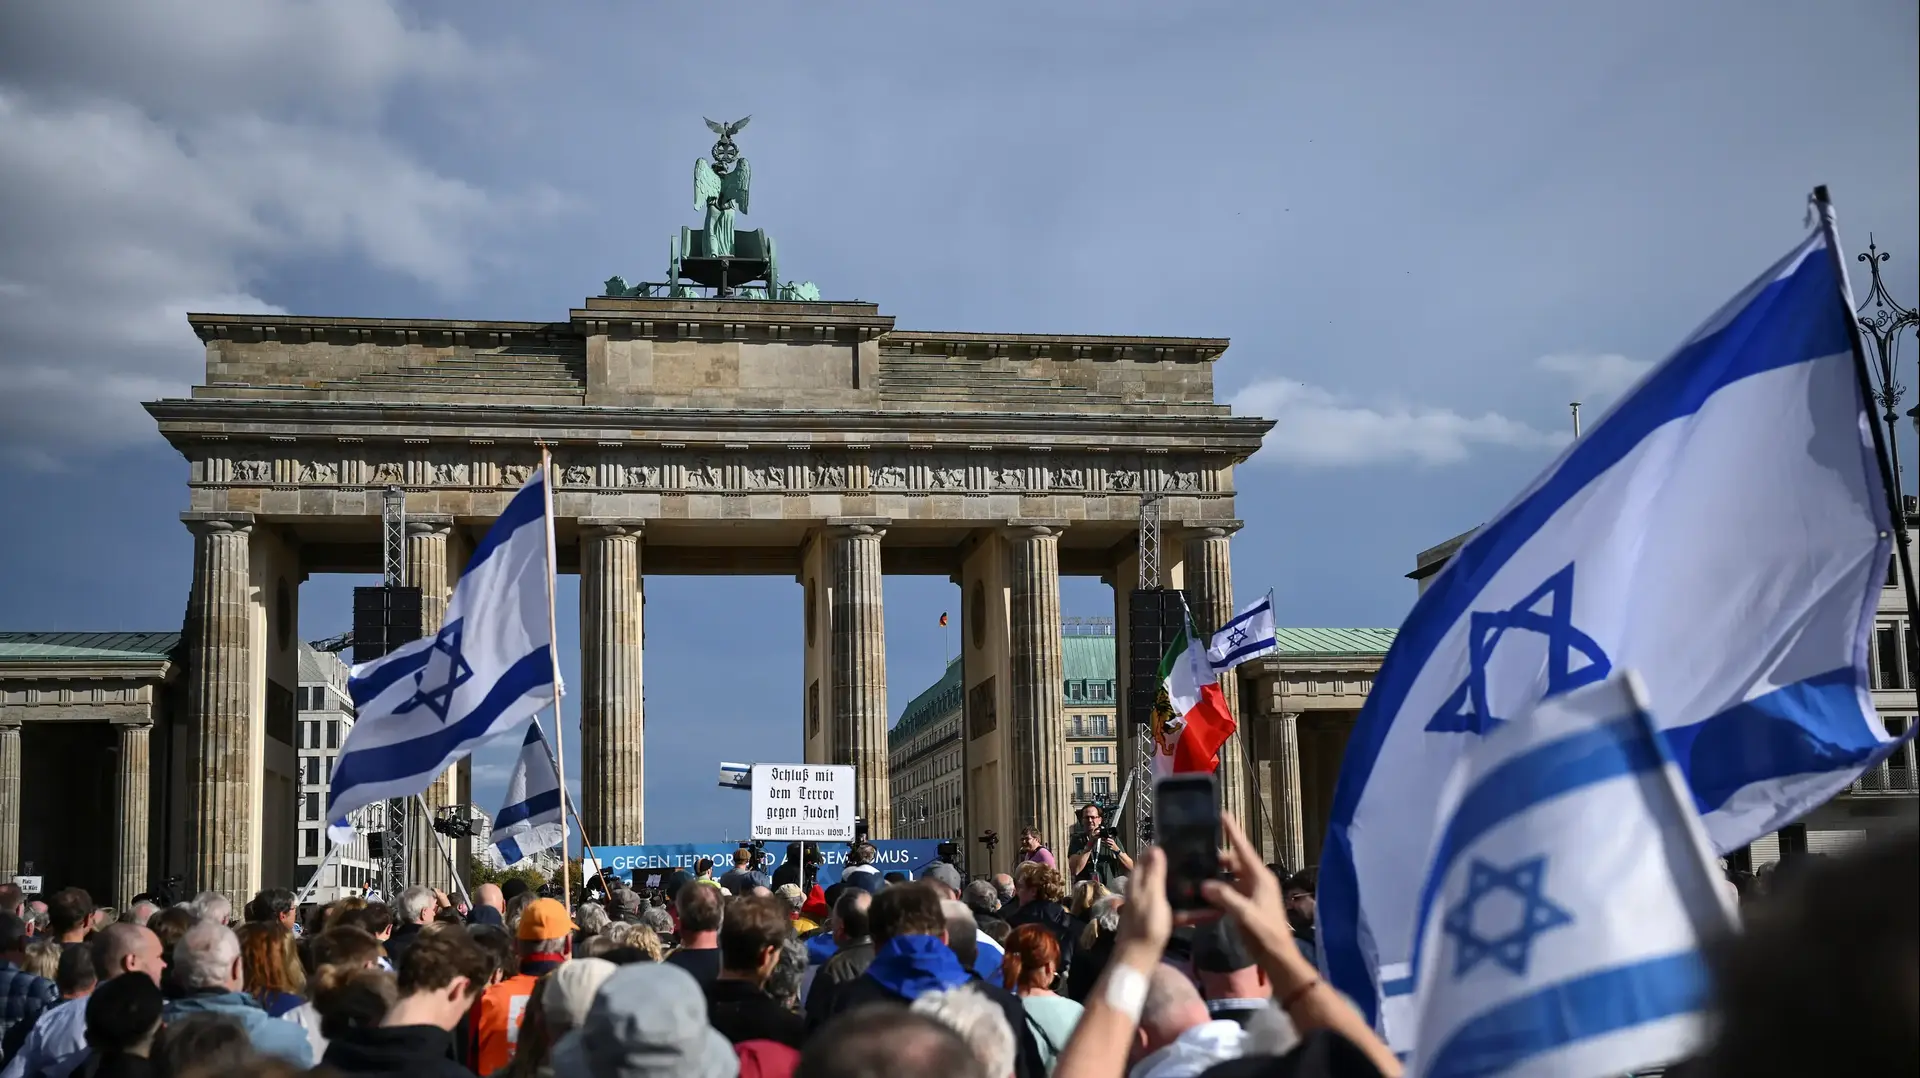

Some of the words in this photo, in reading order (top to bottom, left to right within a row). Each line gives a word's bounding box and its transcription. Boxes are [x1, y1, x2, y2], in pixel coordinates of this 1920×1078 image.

[771, 767, 809, 783] Schluß
[815, 769, 834, 782] mit
[769, 786, 791, 799] dem
[798, 786, 835, 800] Terror
[766, 806, 797, 820] gegen
[802, 805, 839, 820] Juden!
[755, 825, 772, 836] Weg
[775, 825, 788, 835] mit
[791, 826, 825, 836] Hamas
[612, 854, 670, 870] GEGEN
